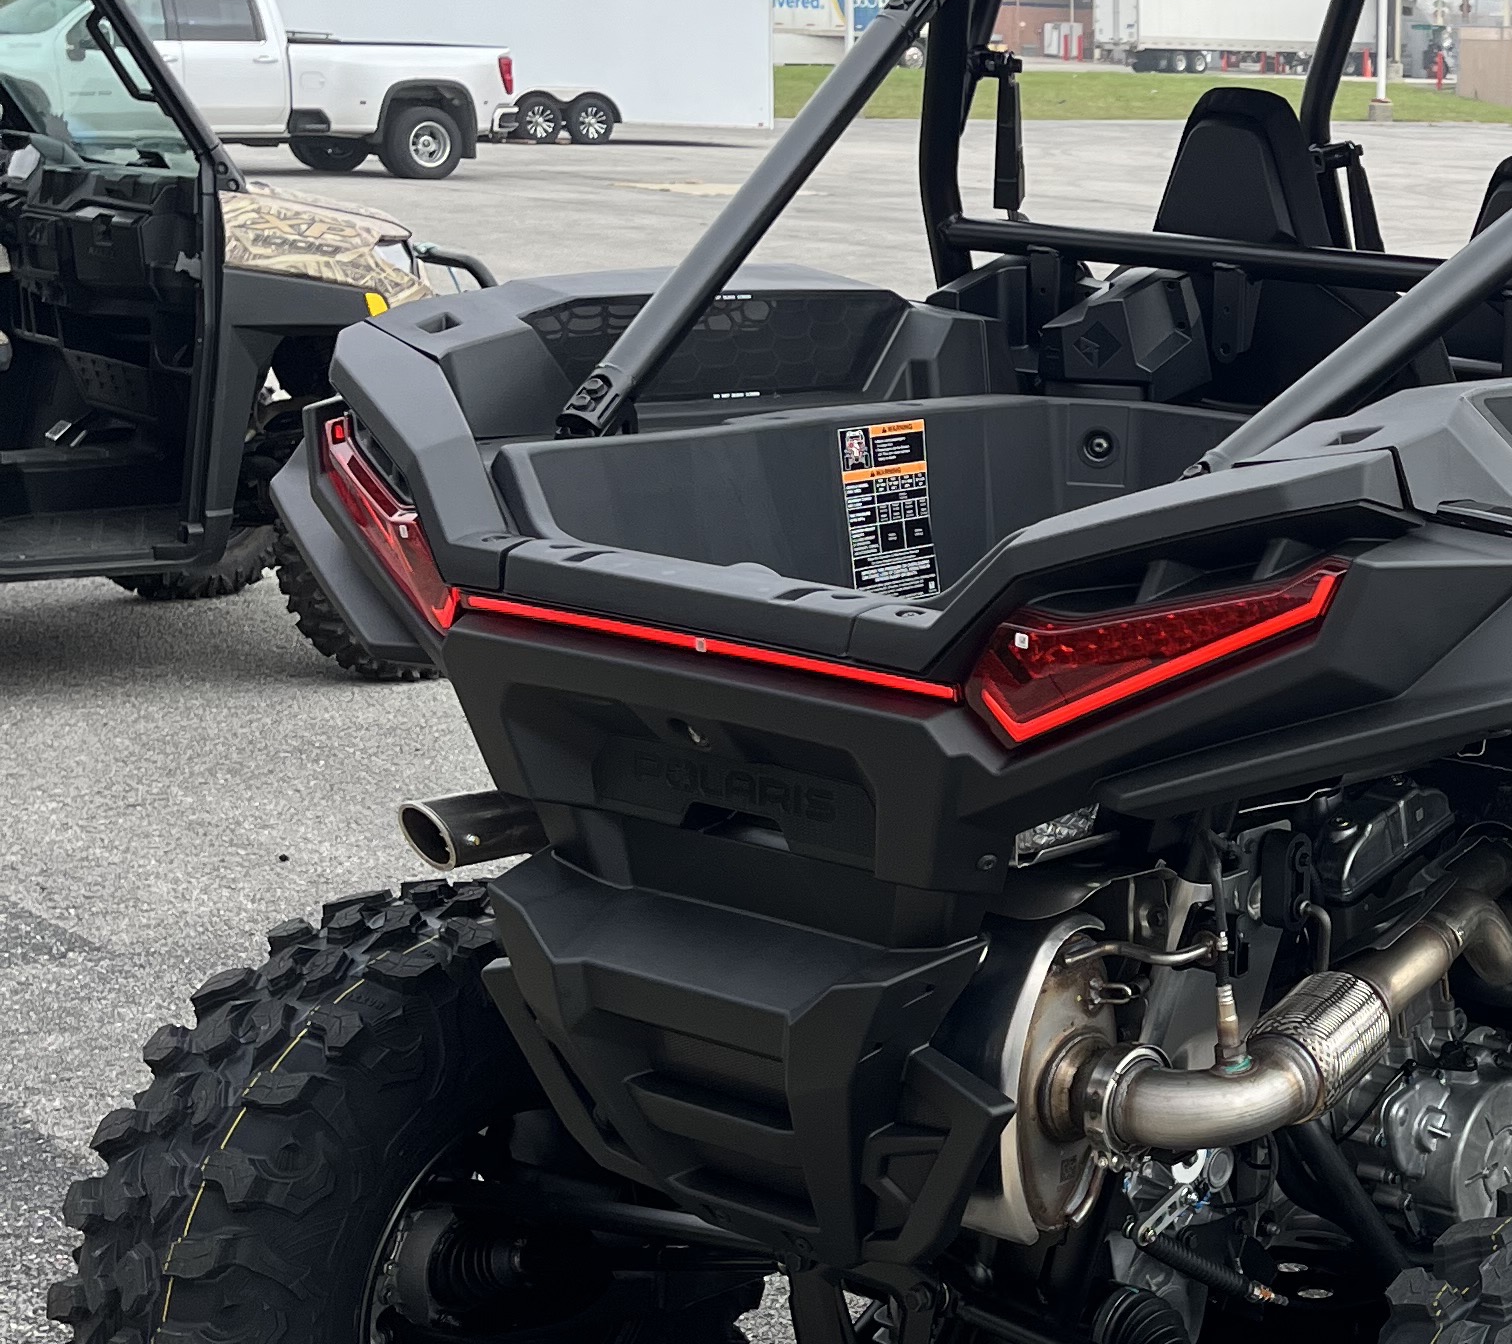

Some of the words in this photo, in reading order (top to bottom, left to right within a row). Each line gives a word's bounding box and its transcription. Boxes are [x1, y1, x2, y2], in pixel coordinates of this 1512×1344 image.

[232, 213, 361, 239] XP
[252, 233, 342, 257] 1000
[633, 749, 838, 825] POLARIS
